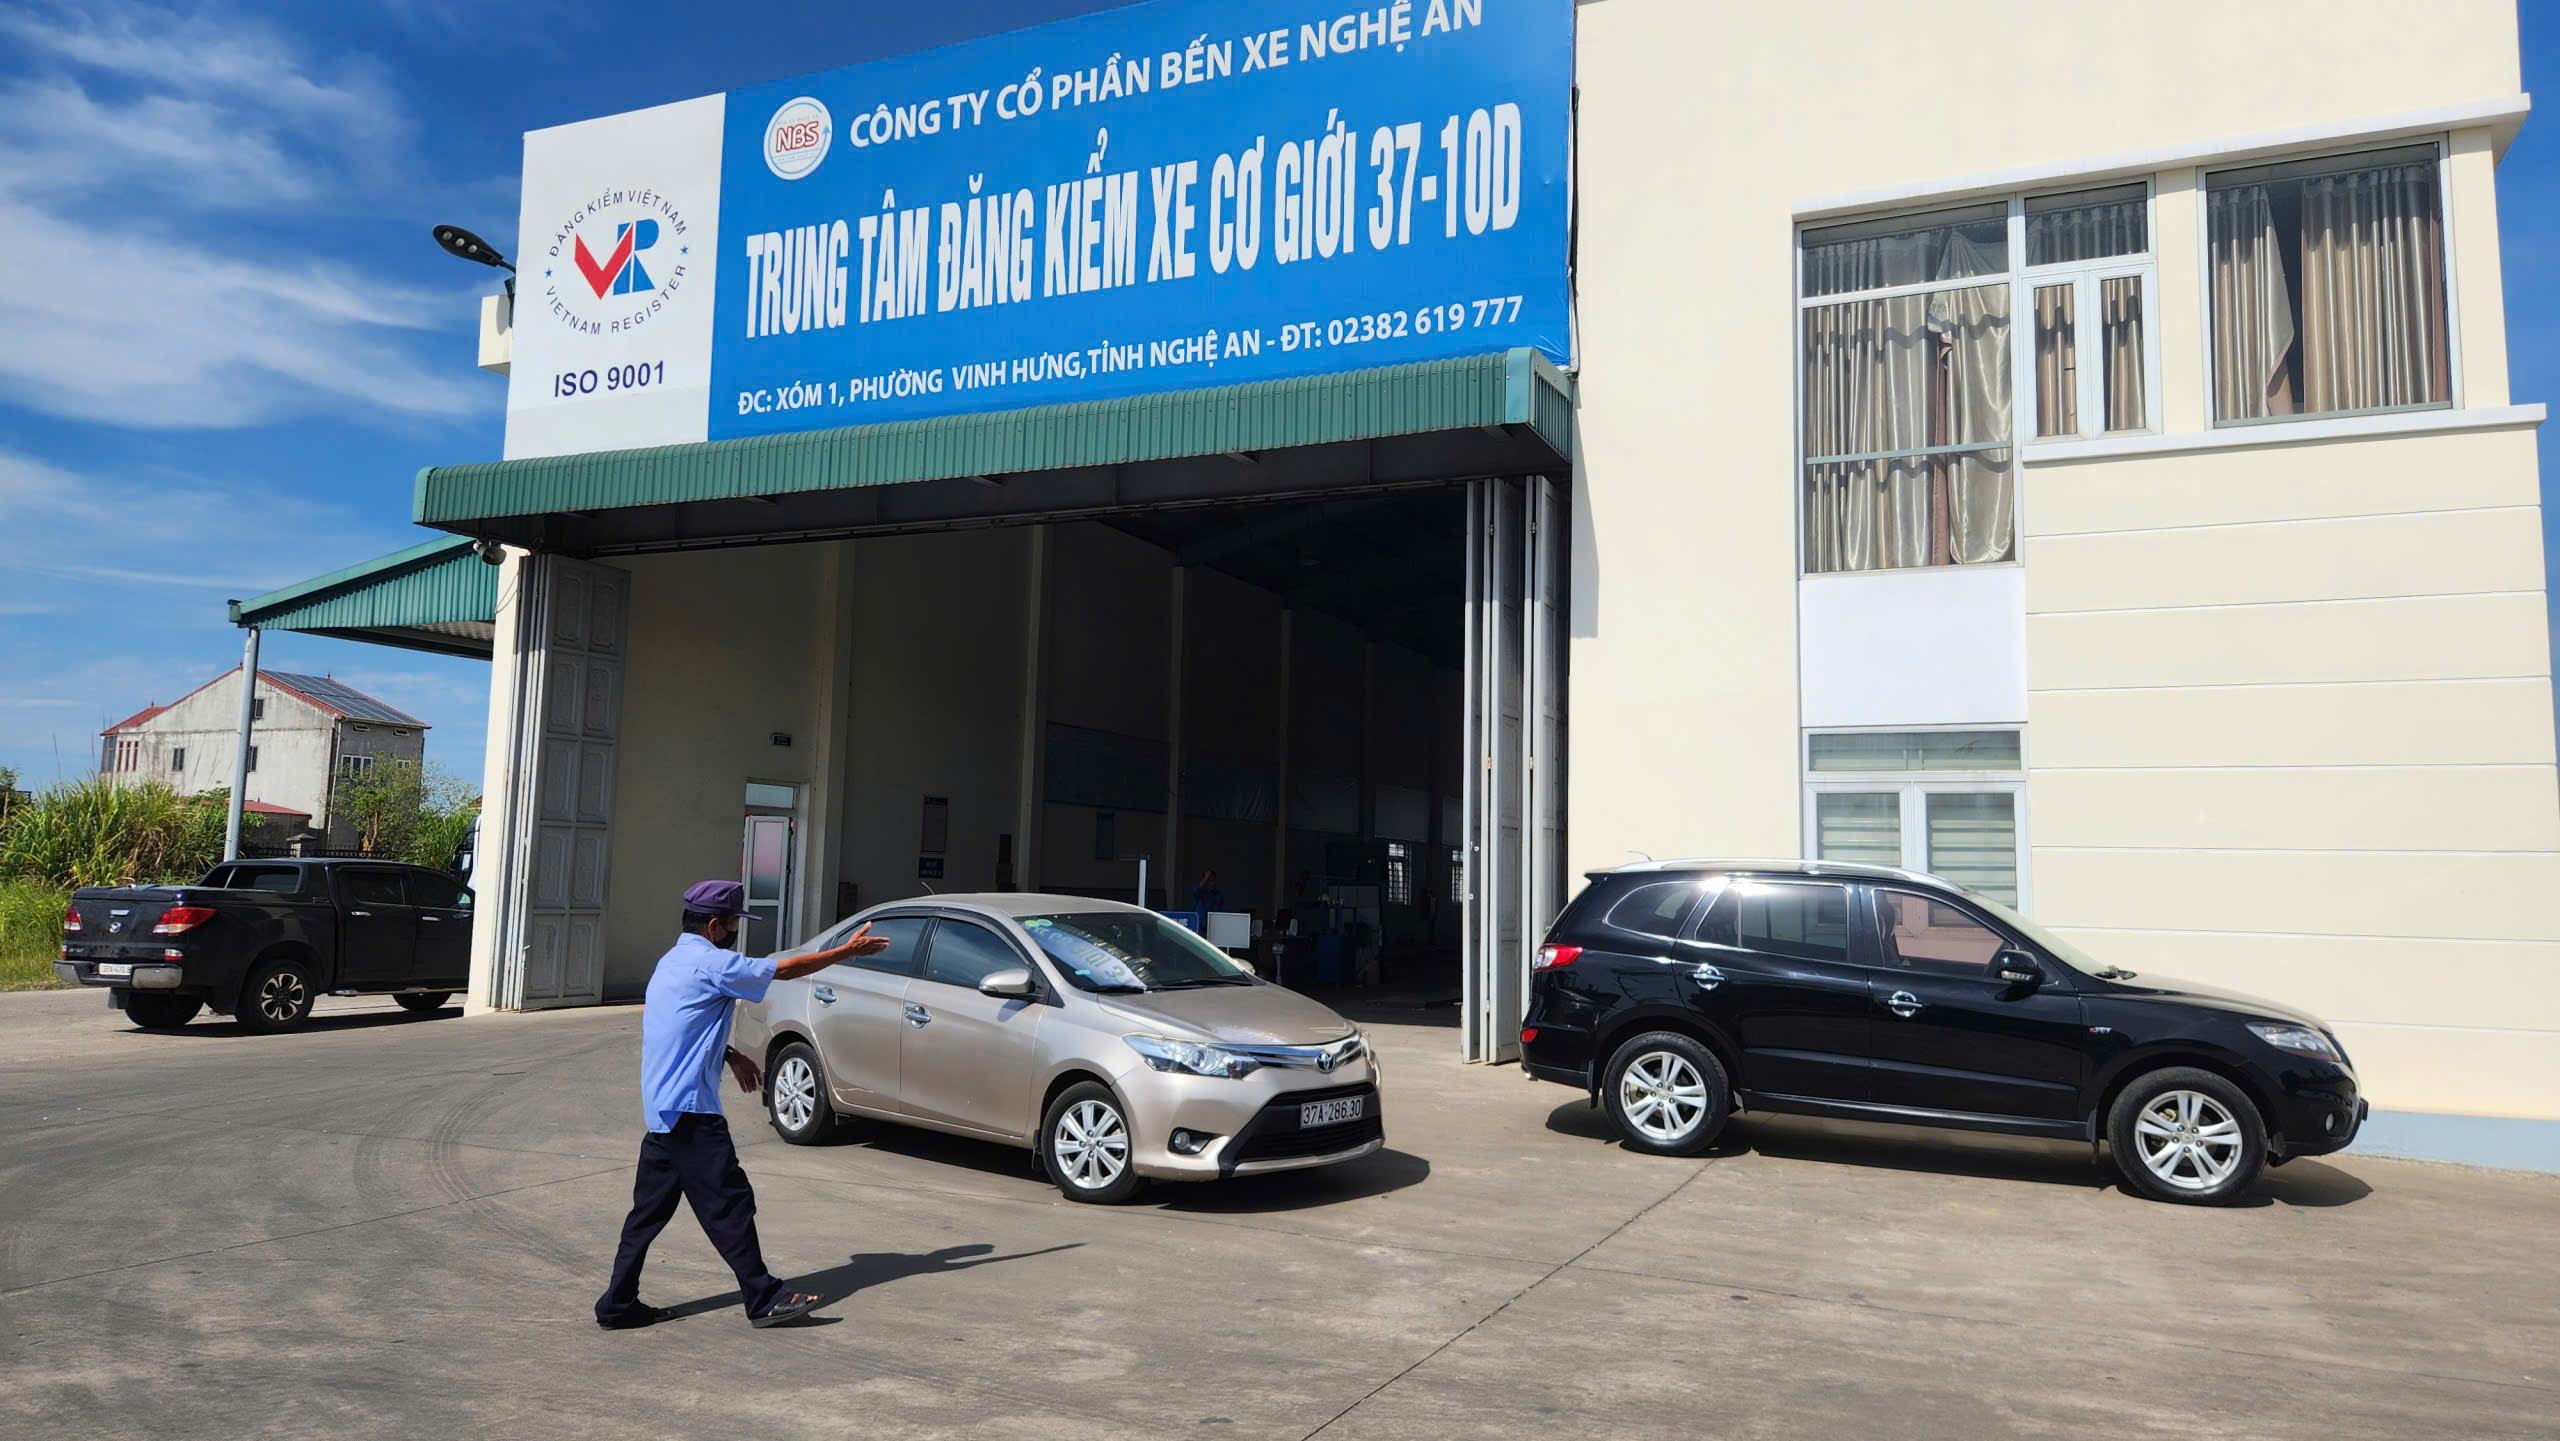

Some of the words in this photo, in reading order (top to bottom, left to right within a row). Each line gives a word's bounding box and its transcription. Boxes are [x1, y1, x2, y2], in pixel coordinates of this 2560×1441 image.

[850, 104, 940, 148] CÔNG
[947, 89, 990, 129] TY
[996, 67, 1043, 120] CỔ
[1051, 52, 1150, 110] PHẦN
[1160, 34, 1232, 89] BẾN
[1241, 28, 1289, 73] XE
[1299, 0, 1412, 61] NGHỆ
[1421, 0, 1482, 37] AN
[776, 121, 819, 153] NBS
[628, 188, 661, 207] VIỆT
[660, 201, 687, 236] NAM
[746, 219, 849, 339] TRUNG
[858, 188, 930, 322] TÂM
[937, 172, 1034, 313] ĐĂNG
[1043, 127, 1139, 297] KIỂM
[1147, 160, 1198, 283] XE
[1209, 135, 1265, 274] CƠ
[1274, 107, 1357, 265] GIỚI
[1368, 102, 1521, 250] 37-10D
[546, 285, 601, 335] VIETNAM
[611, 264, 686, 334] REGISTER
[554, 369, 598, 398] ISO
[607, 360, 664, 391] 9001
[737, 389, 772, 415] ĐC:
[775, 380, 822, 412] XÓM
[828, 382, 845, 408] 1,
[850, 368, 943, 402] PHƯỜNG
[951, 361, 1007, 390] VINH
[1150, 329, 1218, 368] NGHỆ
[1223, 329, 1260, 359] AN
[1280, 321, 1322, 352] ĐT:
[1327, 310, 1408, 346] 02382
[1414, 303, 1465, 343] 619
[1472, 295, 1523, 327] 777
[1303, 1099, 1361, 1124] 37A-286.30
